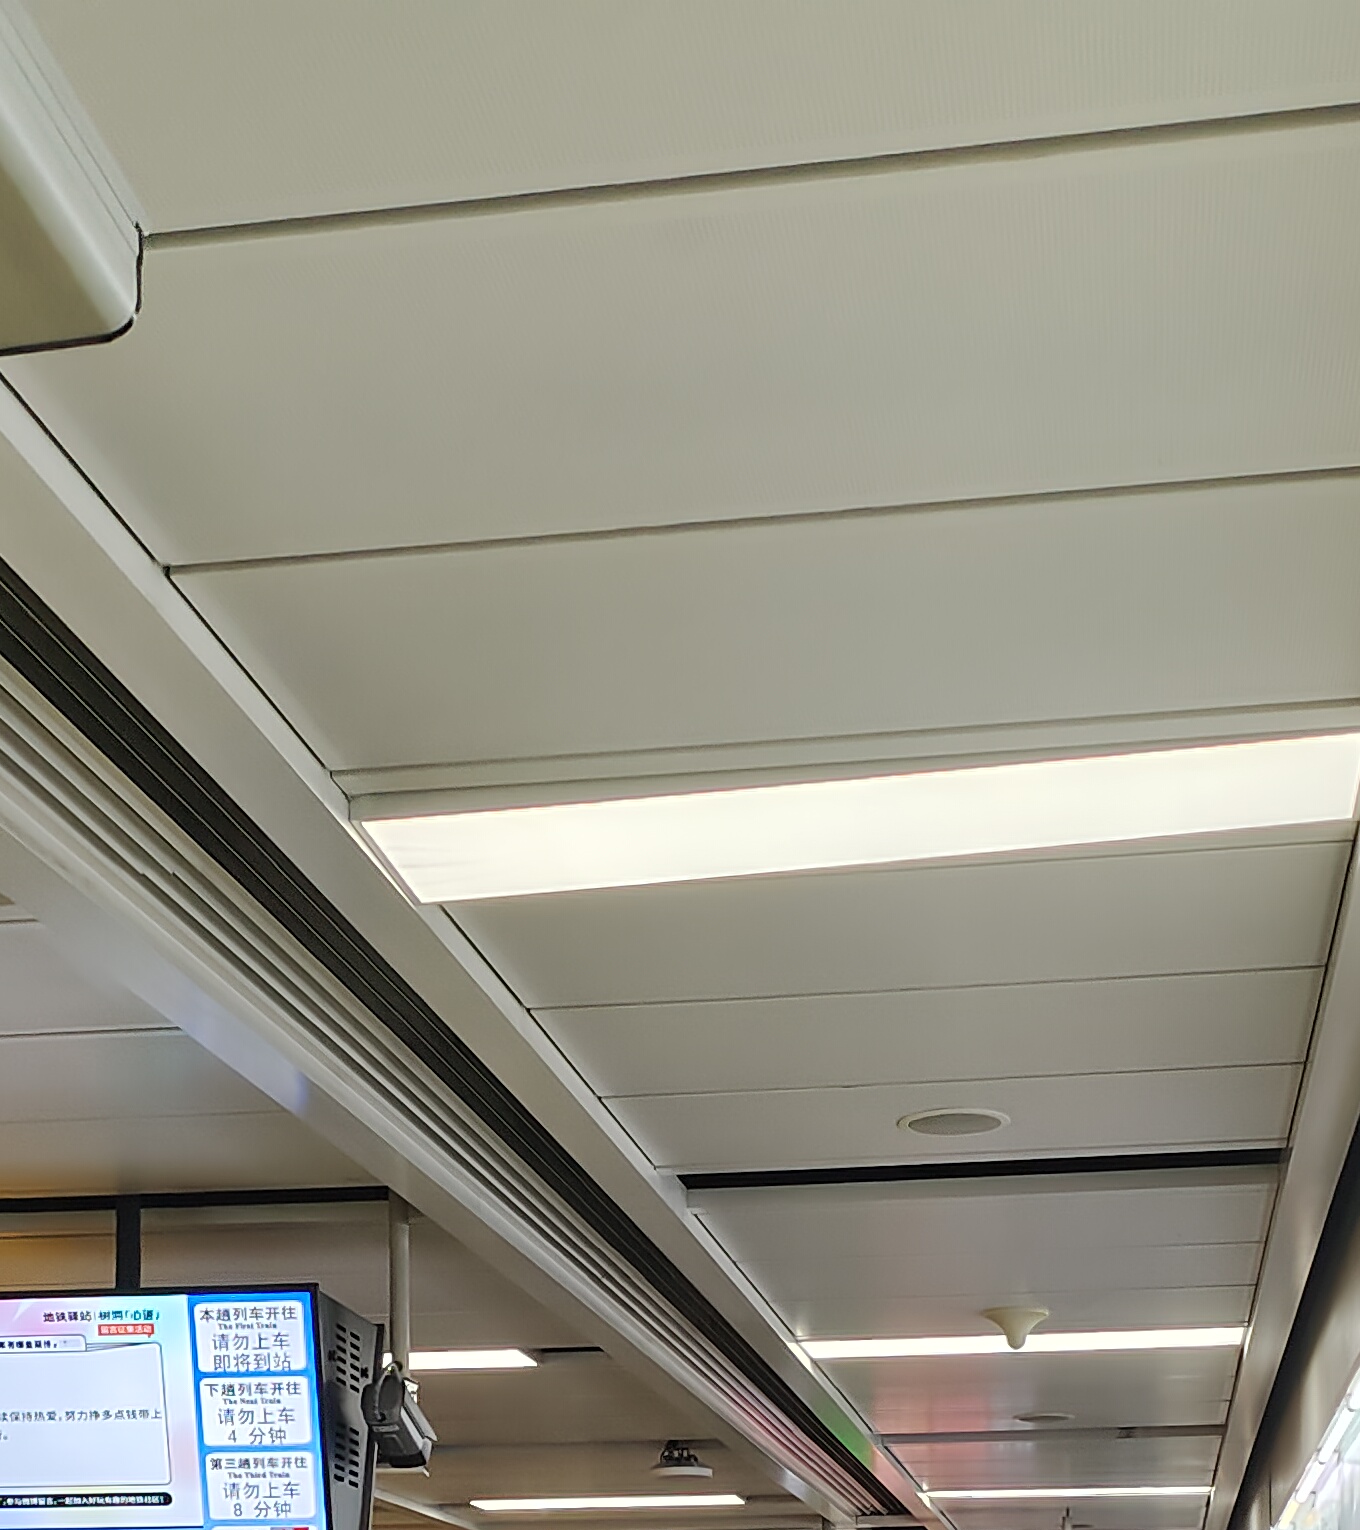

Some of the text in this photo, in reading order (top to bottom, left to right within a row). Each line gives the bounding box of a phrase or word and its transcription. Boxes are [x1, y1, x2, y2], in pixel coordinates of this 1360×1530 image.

[200, 1305, 298, 1323] 本趟列车开往
[212, 1332, 291, 1351] 请勿上车
[213, 1352, 291, 1373] 即将到站
[204, 1382, 302, 1397] 下趟列车开往
[218, 1407, 295, 1426] 请勿上车
[228, 1427, 287, 1445] 4 分钟
[210, 1456, 308, 1470] 第三趟列车开往
[223, 1481, 301, 1500] 请勿上车
[233, 1500, 292, 1518] 8 分钟
